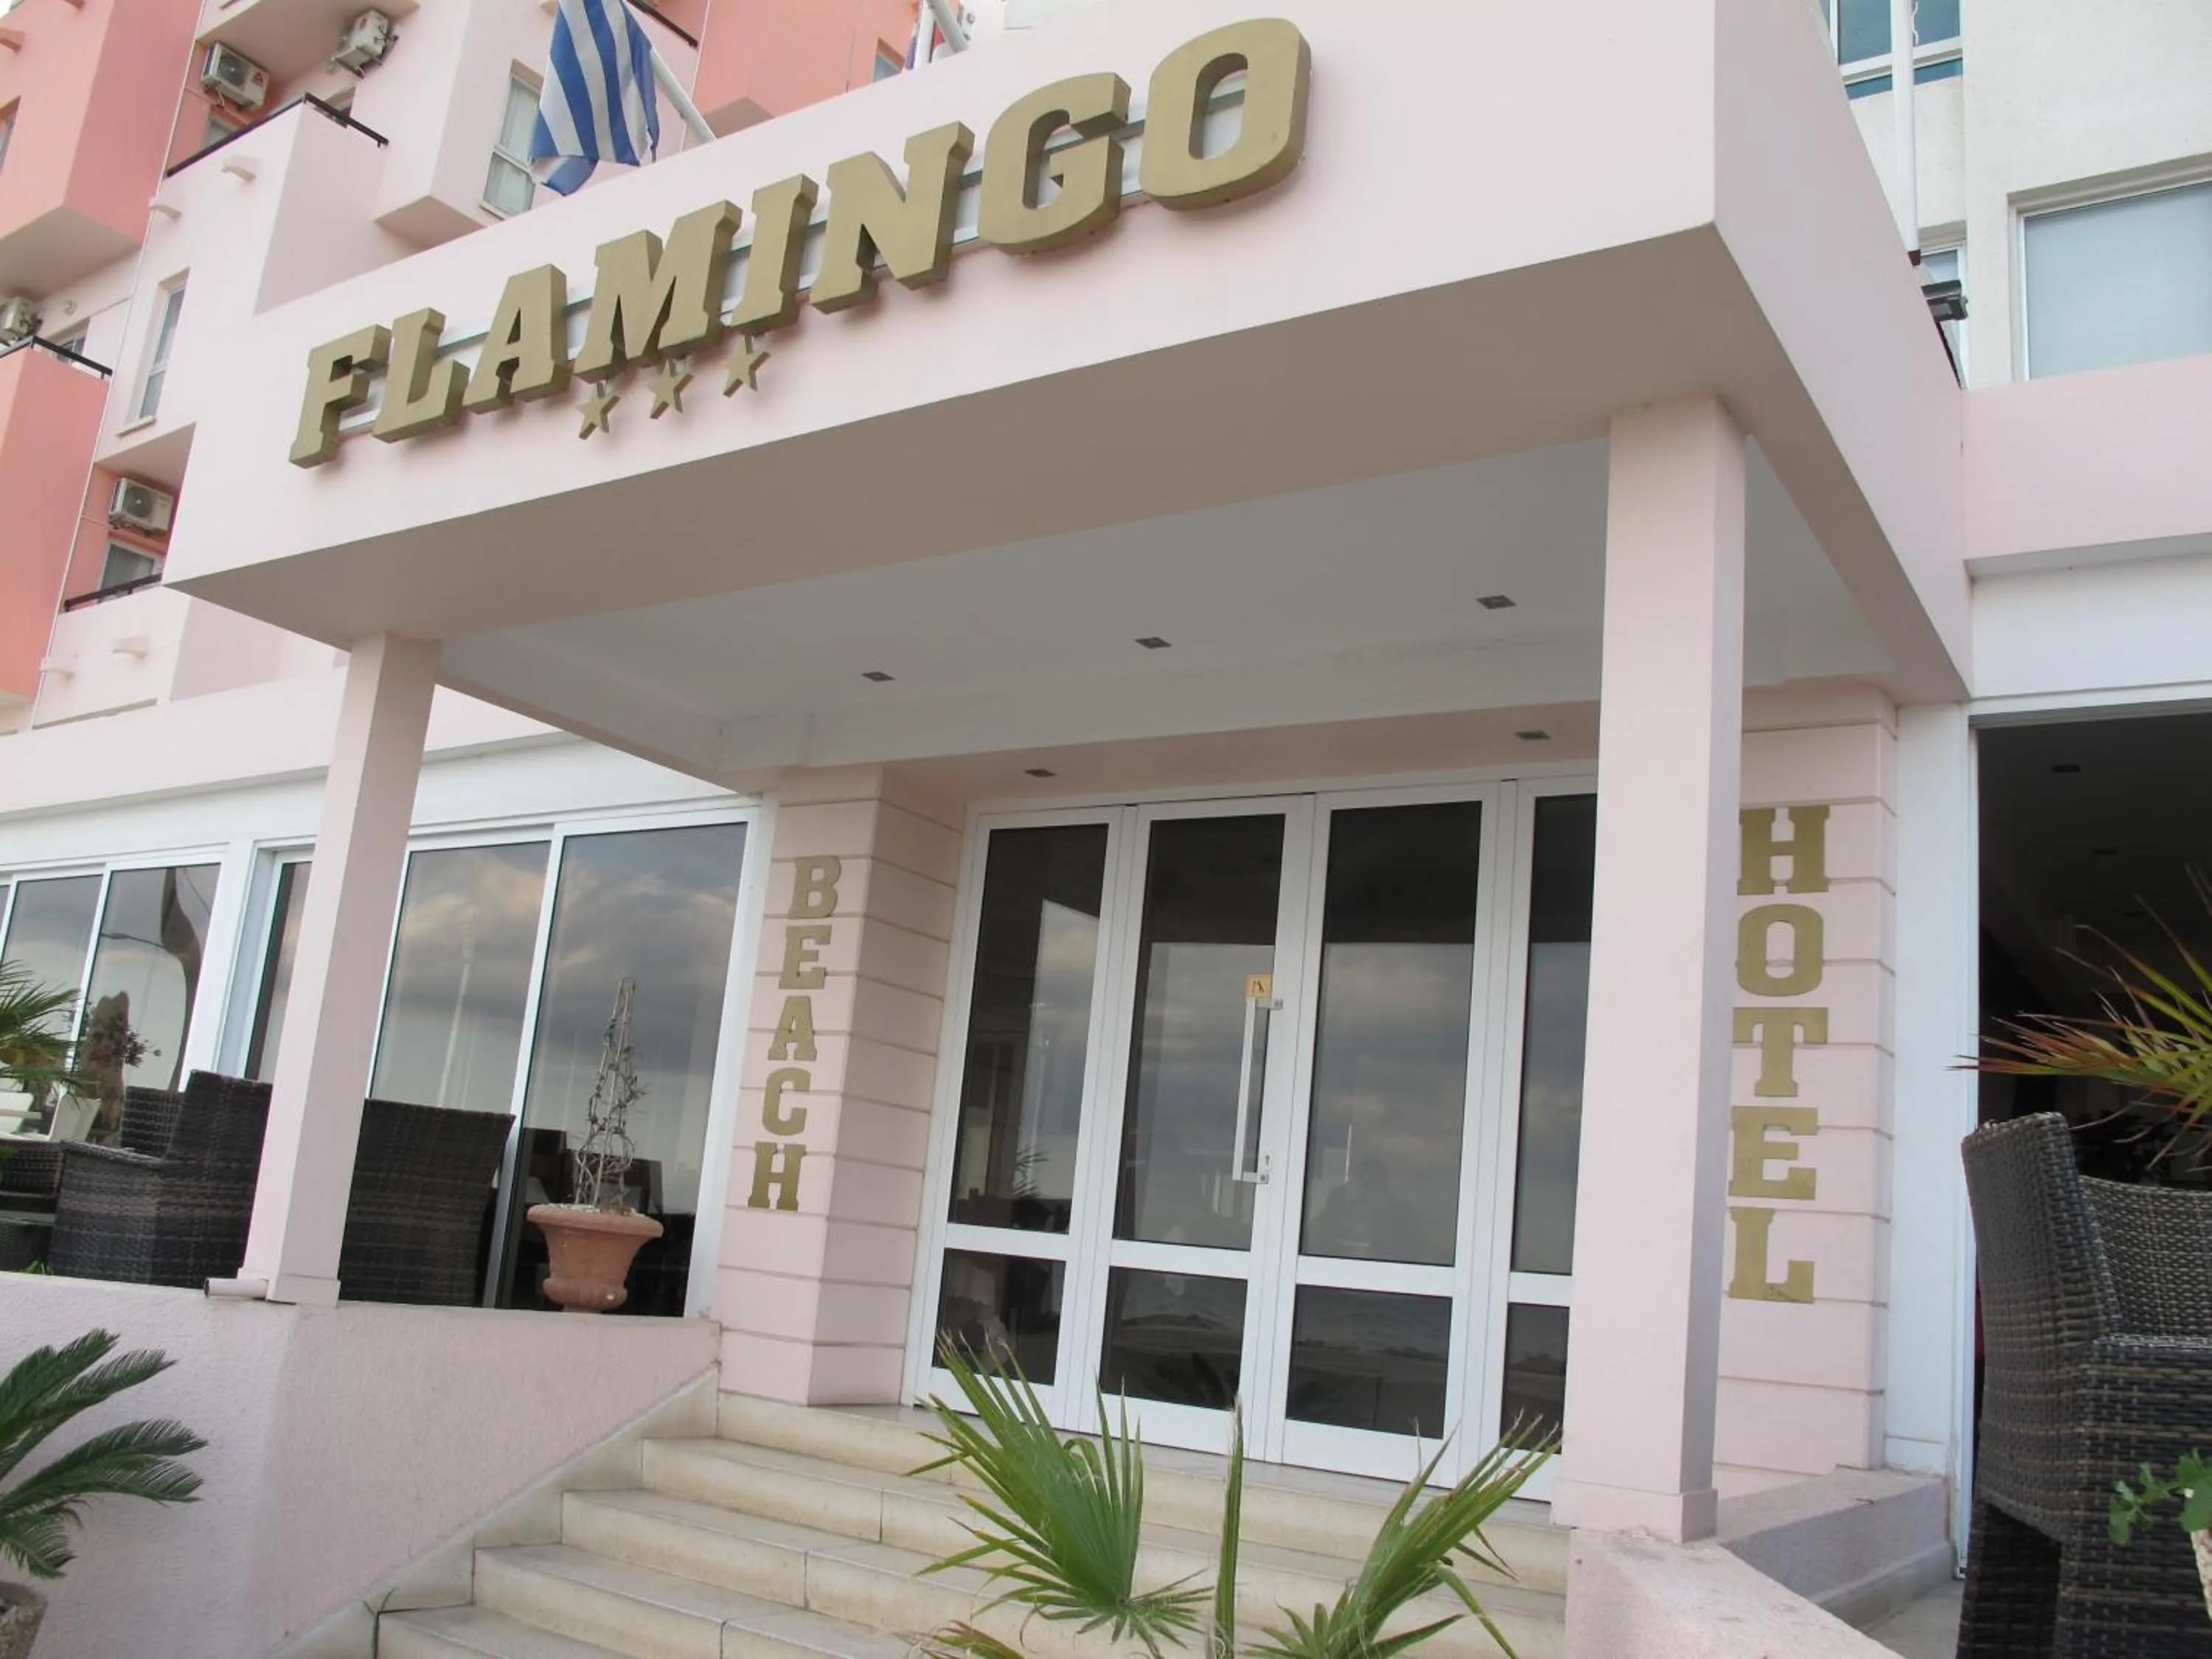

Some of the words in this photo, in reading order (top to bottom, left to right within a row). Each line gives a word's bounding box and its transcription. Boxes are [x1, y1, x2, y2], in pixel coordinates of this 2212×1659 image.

[289, 17, 1312, 469] FLAMINGO
[747, 855, 841, 1211] BEACH
[1728, 804, 1831, 1304] HOTEL
